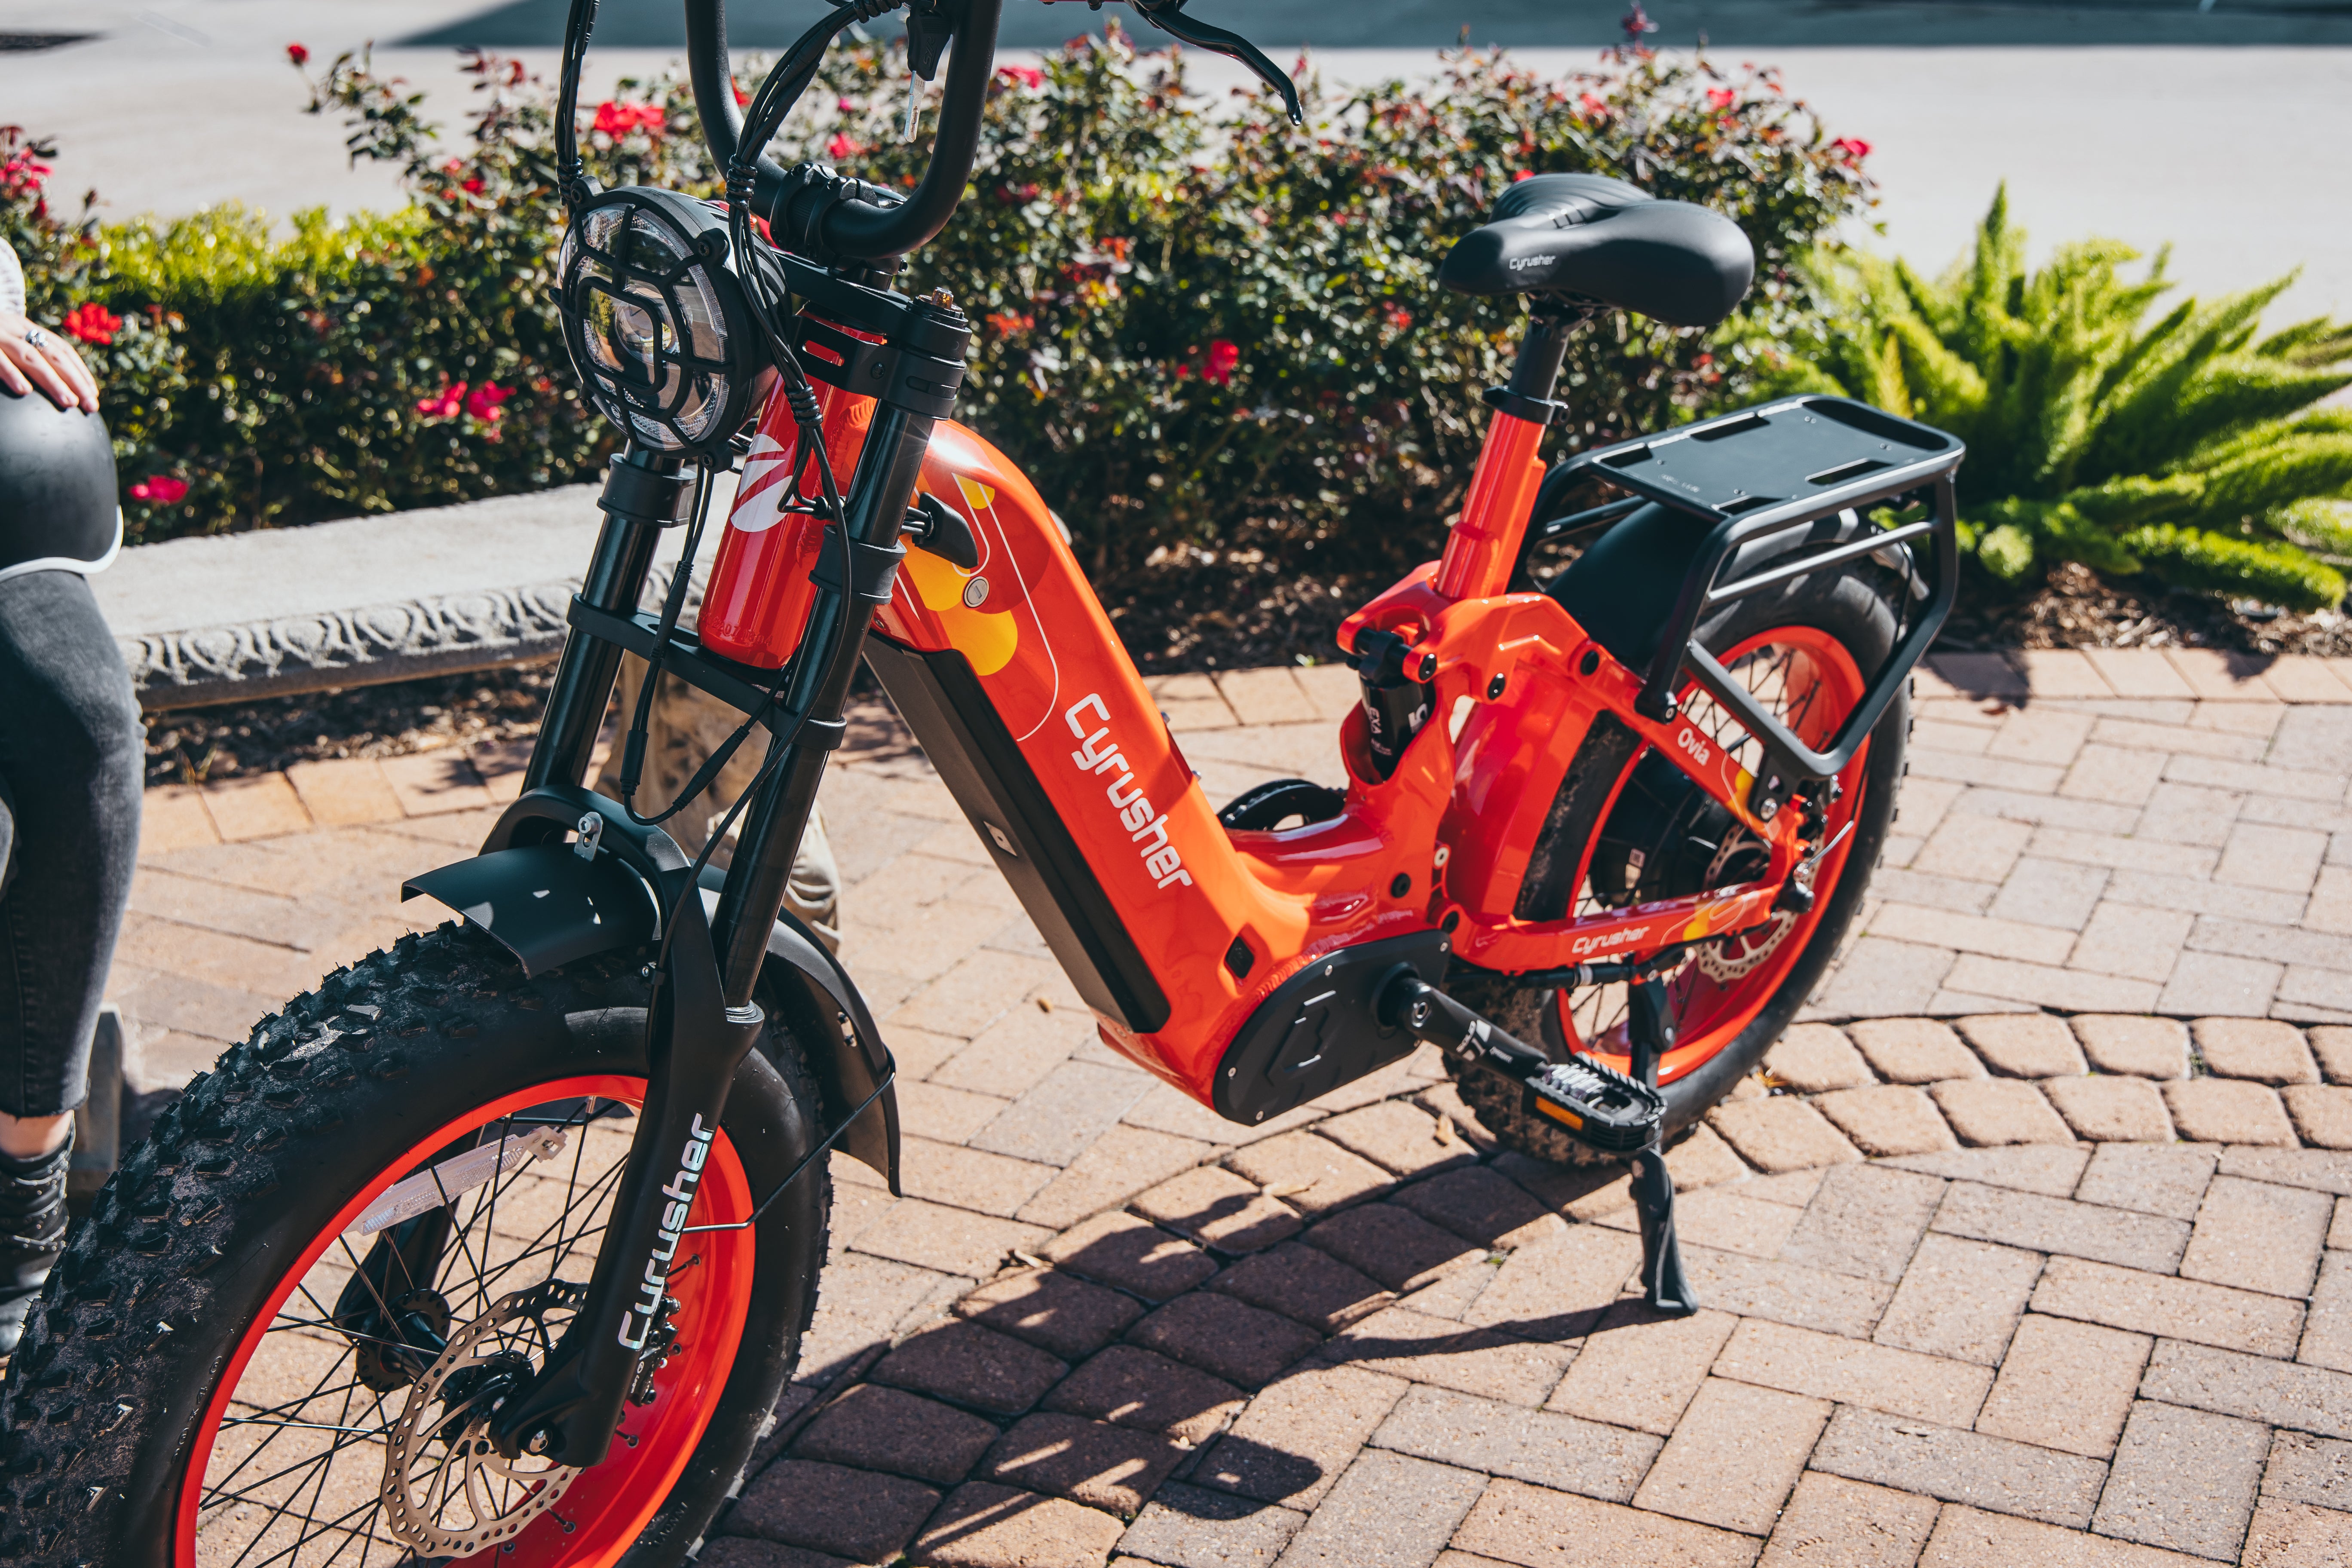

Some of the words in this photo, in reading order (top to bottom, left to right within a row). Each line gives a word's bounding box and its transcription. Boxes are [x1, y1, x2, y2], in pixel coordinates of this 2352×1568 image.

[1509, 254, 1556, 271] Cyrusher
[1678, 728, 1710, 766] Ovia
[1065, 693, 1193, 889] Cyrusher
[1572, 927, 1649, 955] Cyrusher
[618, 1112, 714, 1350] Cyrusher
[468, 1423, 477, 1437] 180
